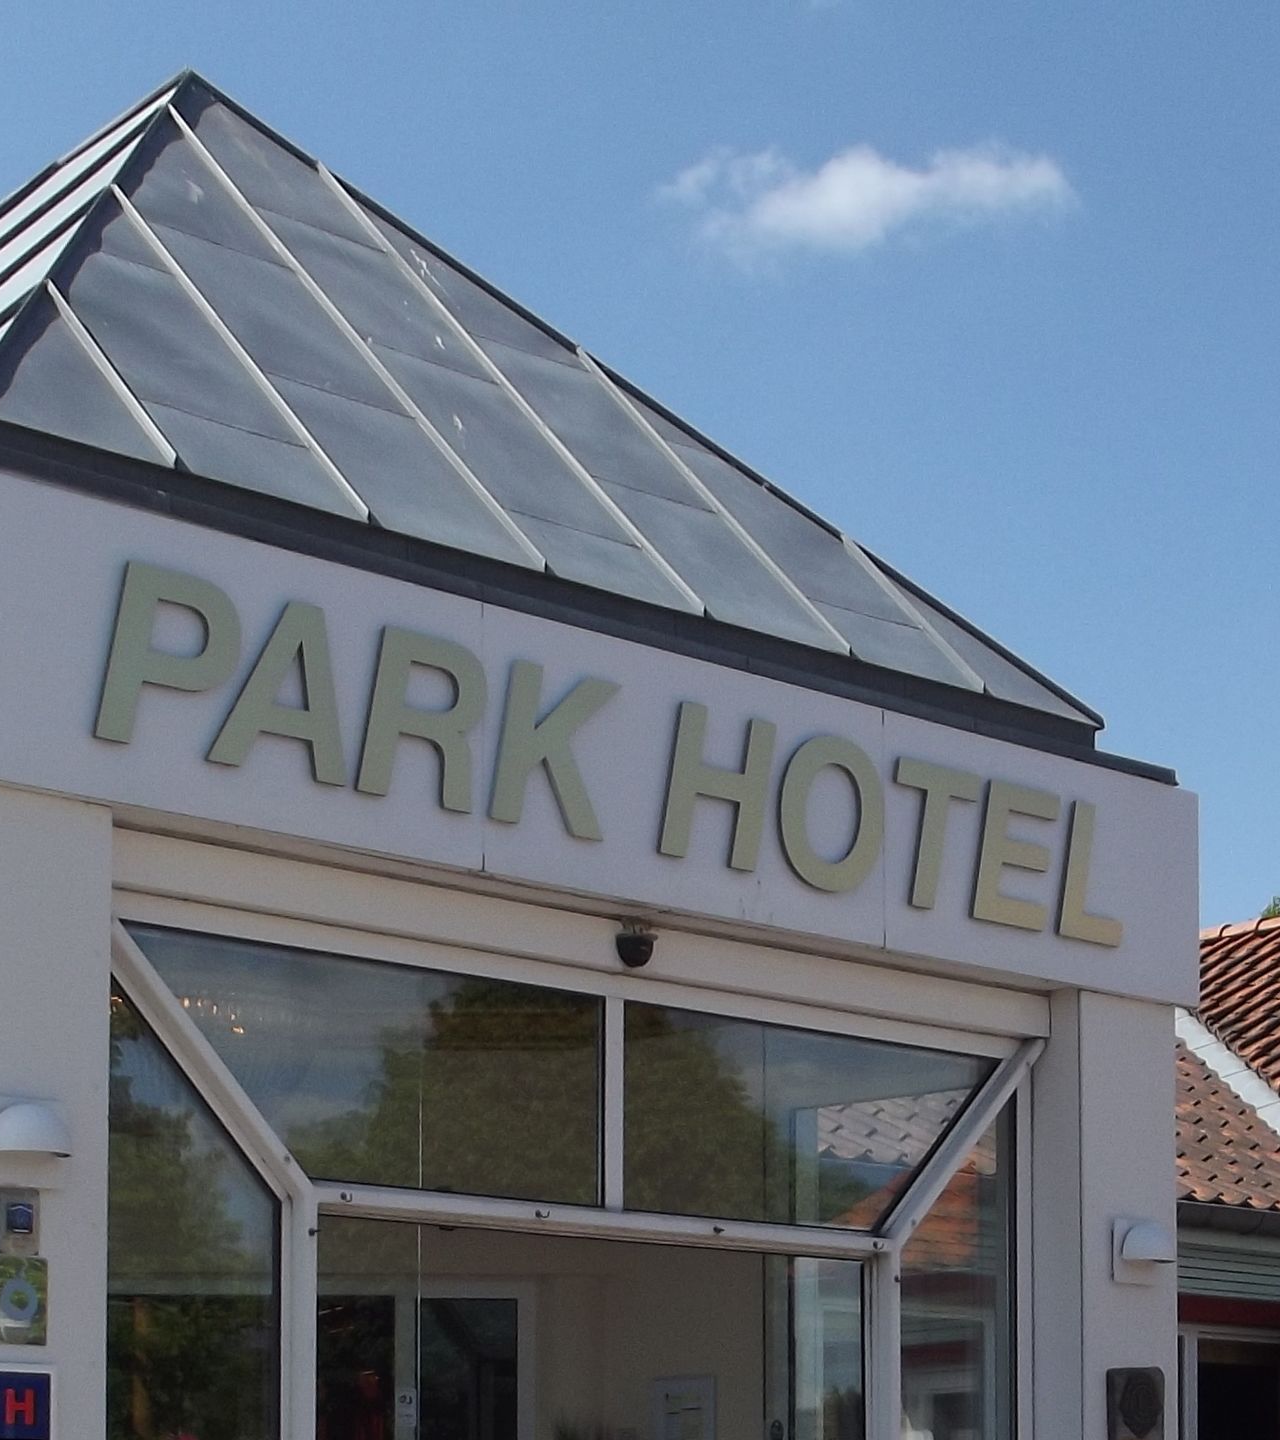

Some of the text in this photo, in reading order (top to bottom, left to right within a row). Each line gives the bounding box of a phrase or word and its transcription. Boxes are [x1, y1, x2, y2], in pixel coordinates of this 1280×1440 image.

[93, 560, 1123, 948] PARK HOTEL
[4, 1388, 35, 1426] H
